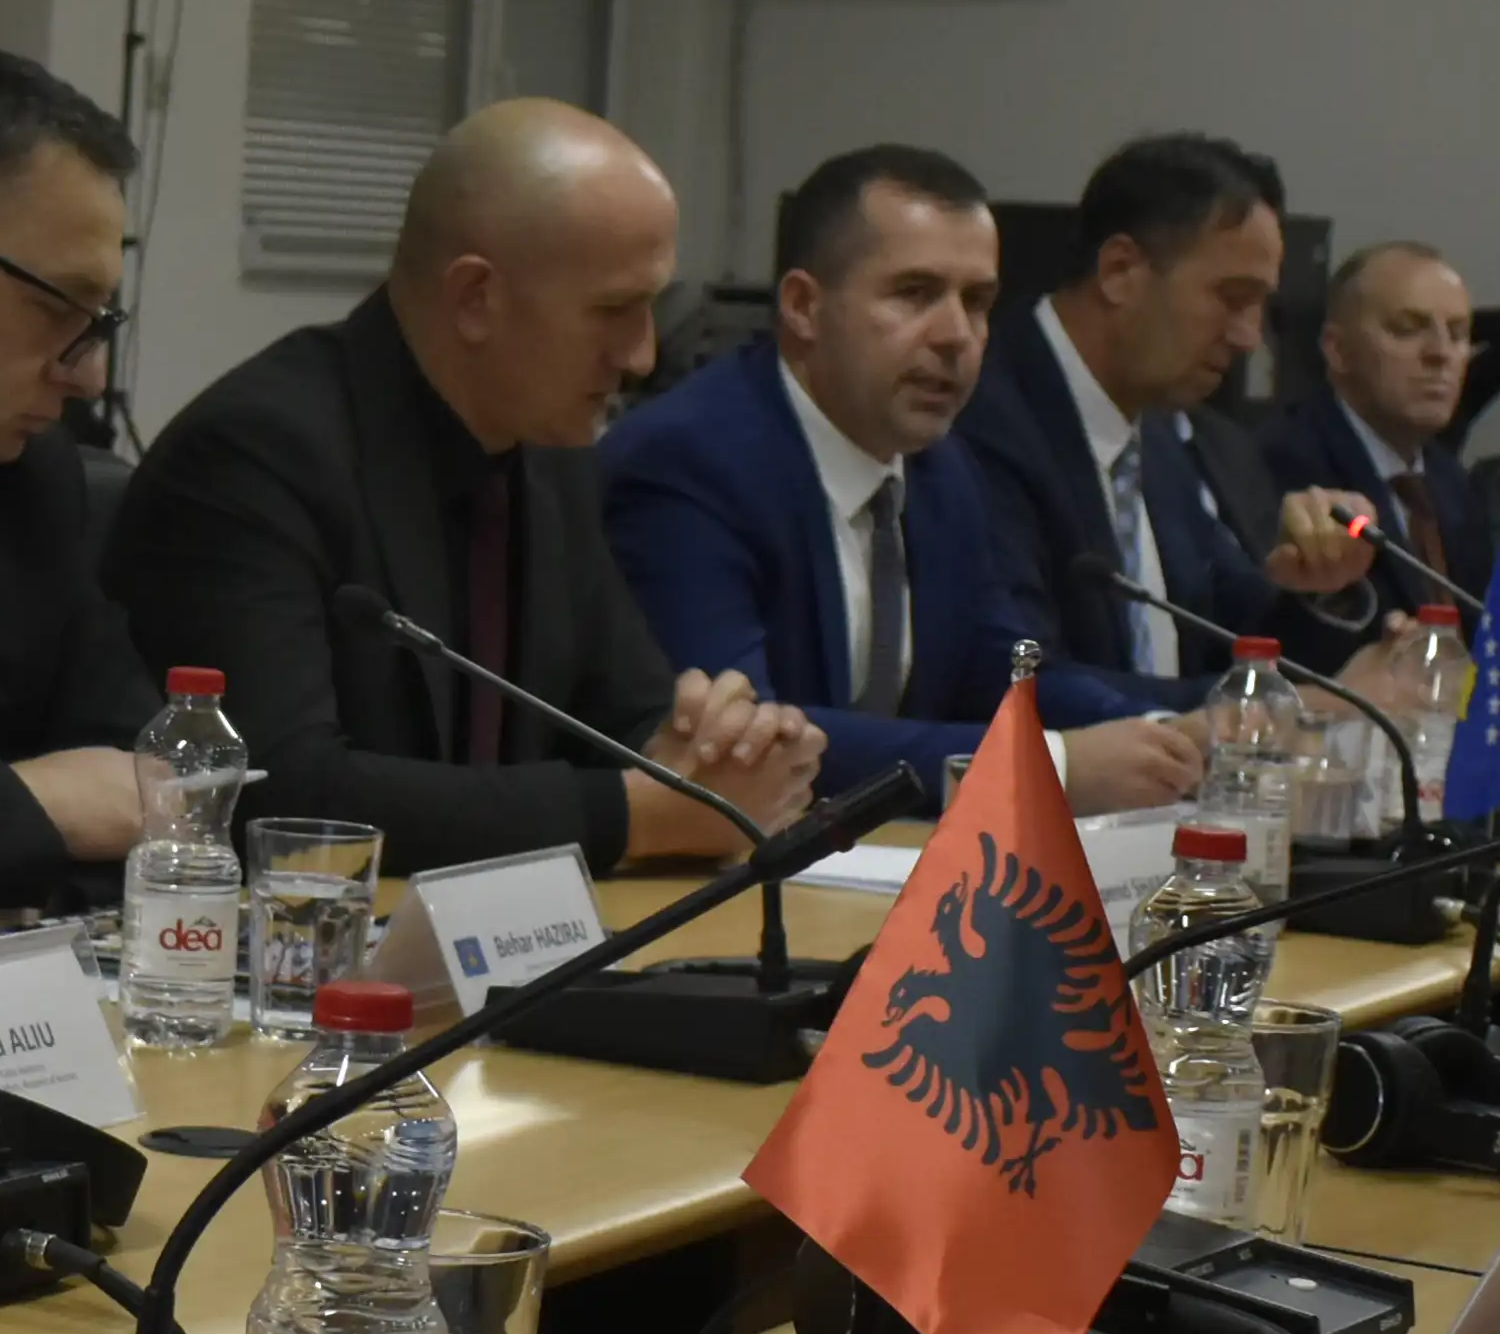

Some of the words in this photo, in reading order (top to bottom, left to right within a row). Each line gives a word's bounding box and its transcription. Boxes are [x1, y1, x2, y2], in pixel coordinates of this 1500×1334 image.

[159, 918, 223, 951] dea
[493, 931, 534, 959] Behar
[9, 1021, 56, 1055] ALIU
